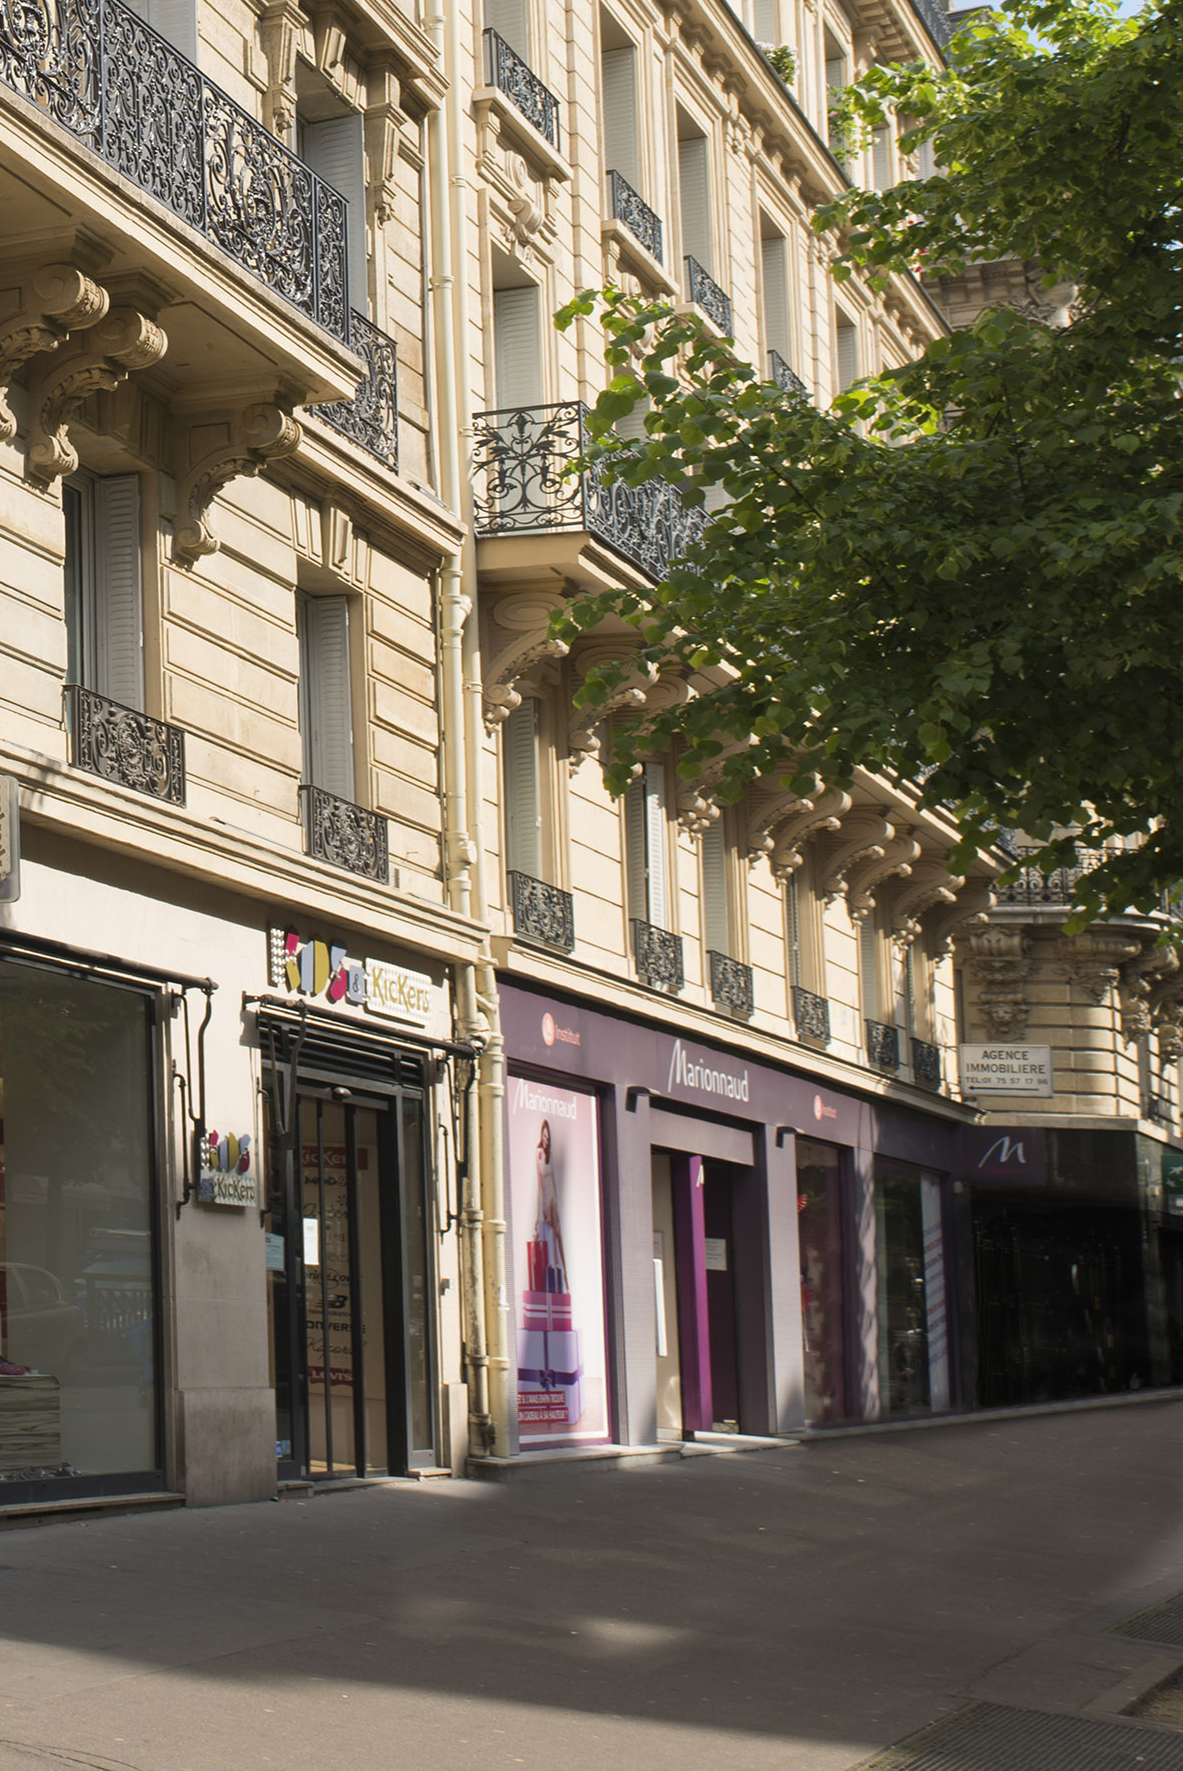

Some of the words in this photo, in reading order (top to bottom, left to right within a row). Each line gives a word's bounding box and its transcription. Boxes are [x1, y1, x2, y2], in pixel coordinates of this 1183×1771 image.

[270, 928, 347, 1001] KIDS
[667, 1036, 750, 1103] Marionnaud
[965, 1063, 1046, 1075] IMMOBILIERE
[981, 1050, 1030, 1061] AGENCE
[512, 1078, 577, 1120] Marionnaud
